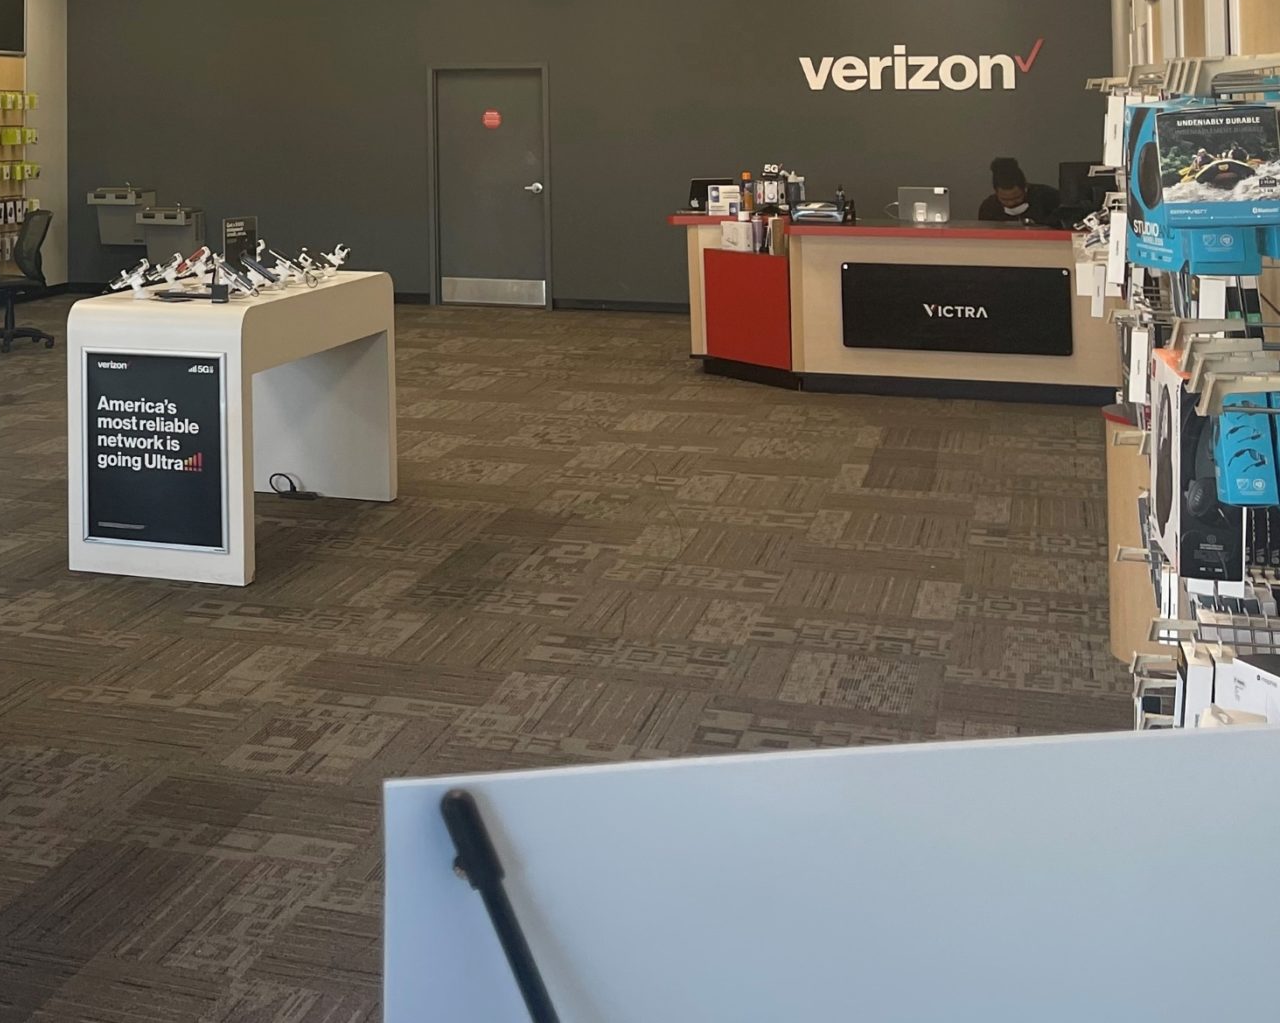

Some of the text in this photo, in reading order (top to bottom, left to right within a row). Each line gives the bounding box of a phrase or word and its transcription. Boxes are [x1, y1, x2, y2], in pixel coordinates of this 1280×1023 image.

[798, 44, 1016, 91] verizon
[1177, 116, 1260, 127] UNDENIABLY DURABLE
[763, 164, 779, 173] 5G
[1133, 219, 1160, 237] STUDIO
[923, 304, 988, 318] VICTRA
[97, 360, 127, 370] verizon
[97, 396, 177, 415] America's
[97, 416, 199, 434] most reliable
[97, 435, 180, 451] network is
[97, 452, 142, 471] going
